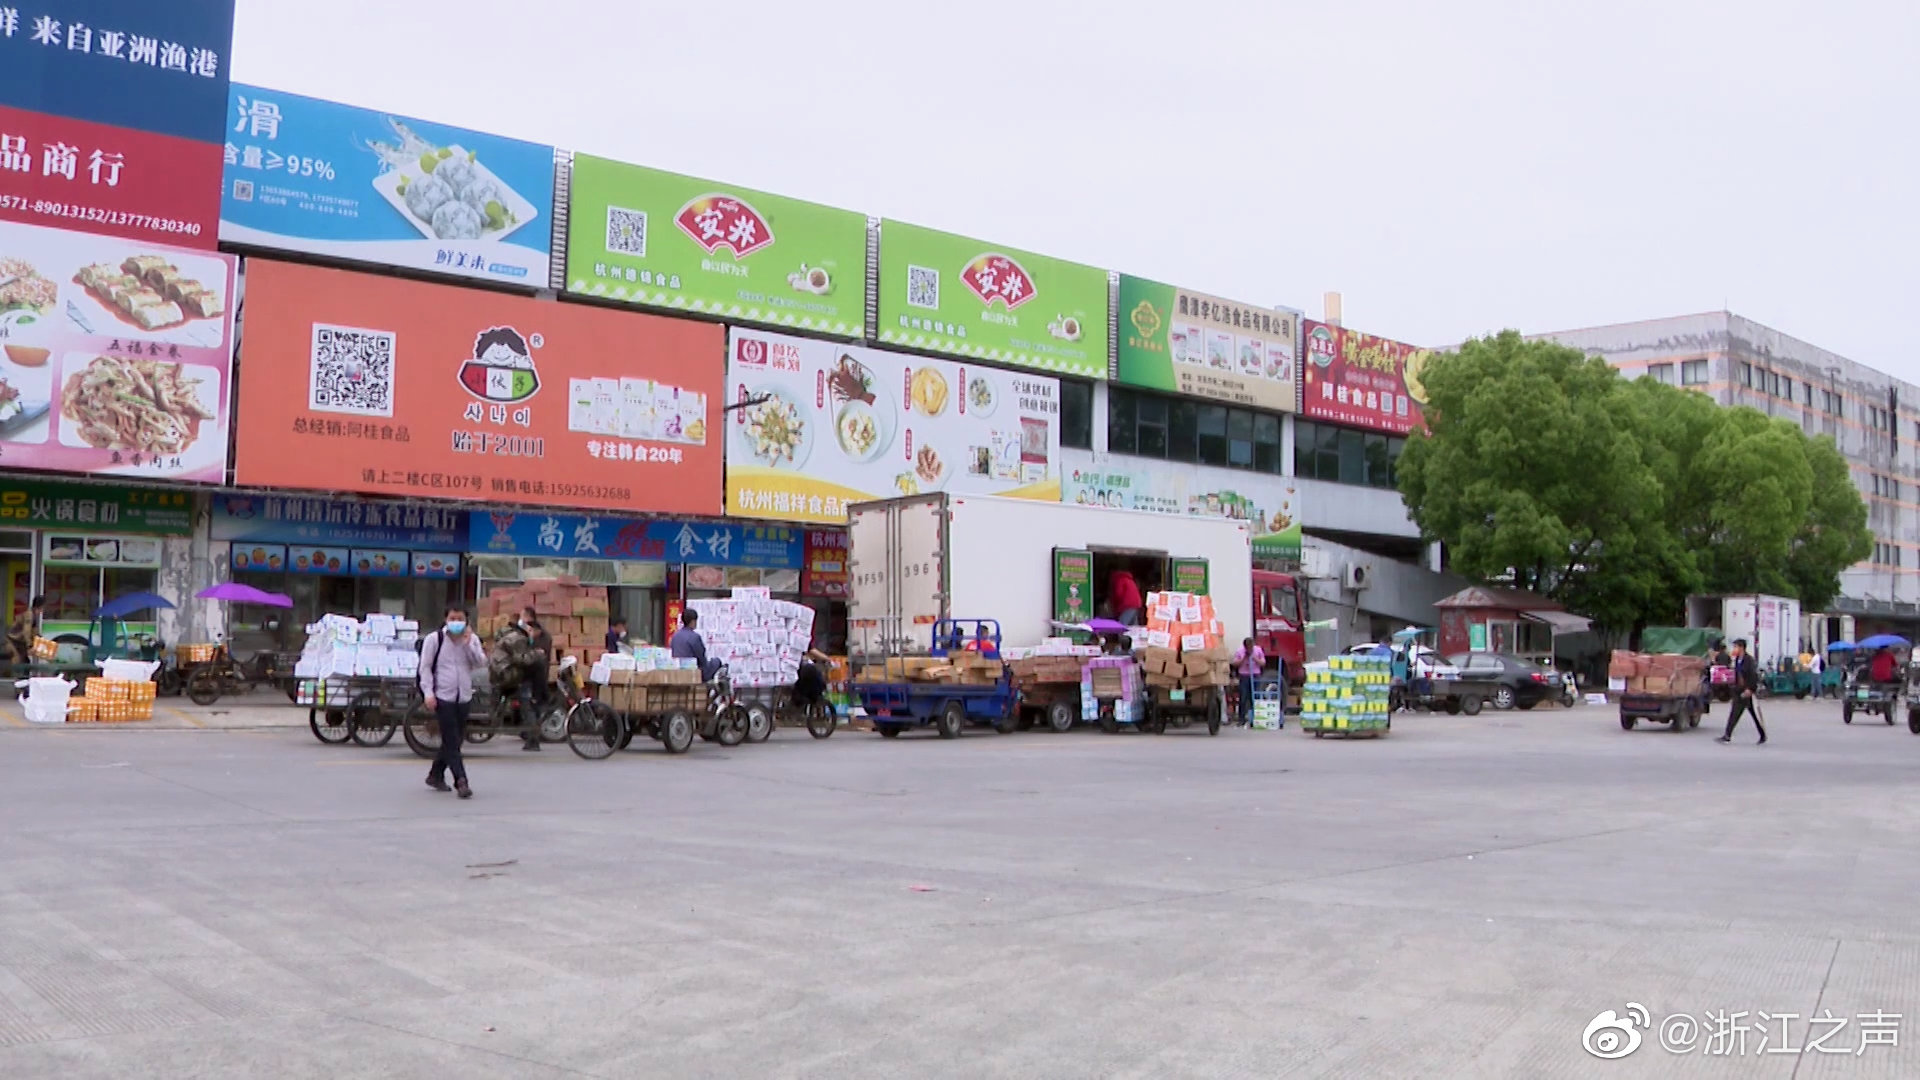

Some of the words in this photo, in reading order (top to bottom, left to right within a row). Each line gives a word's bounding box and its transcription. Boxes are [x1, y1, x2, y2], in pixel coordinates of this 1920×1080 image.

[30, 15, 219, 78] 来自亚洲渔港
[234, 95, 282, 140] 滑
[0, 133, 125, 187] 品商行
[0, 195, 201, 236] 571-89013152/13777830340
[694, 208, 757, 248] 安井
[974, 266, 1023, 302] 安井
[1321, 381, 1378, 410] 阿桂食品
[464, 402, 530, 426] 사나이
[451, 430, 545, 458] 始于2001
[586, 439, 683, 464] 专注韩食20年
[361, 467, 484, 493] 请上二楼C区107号
